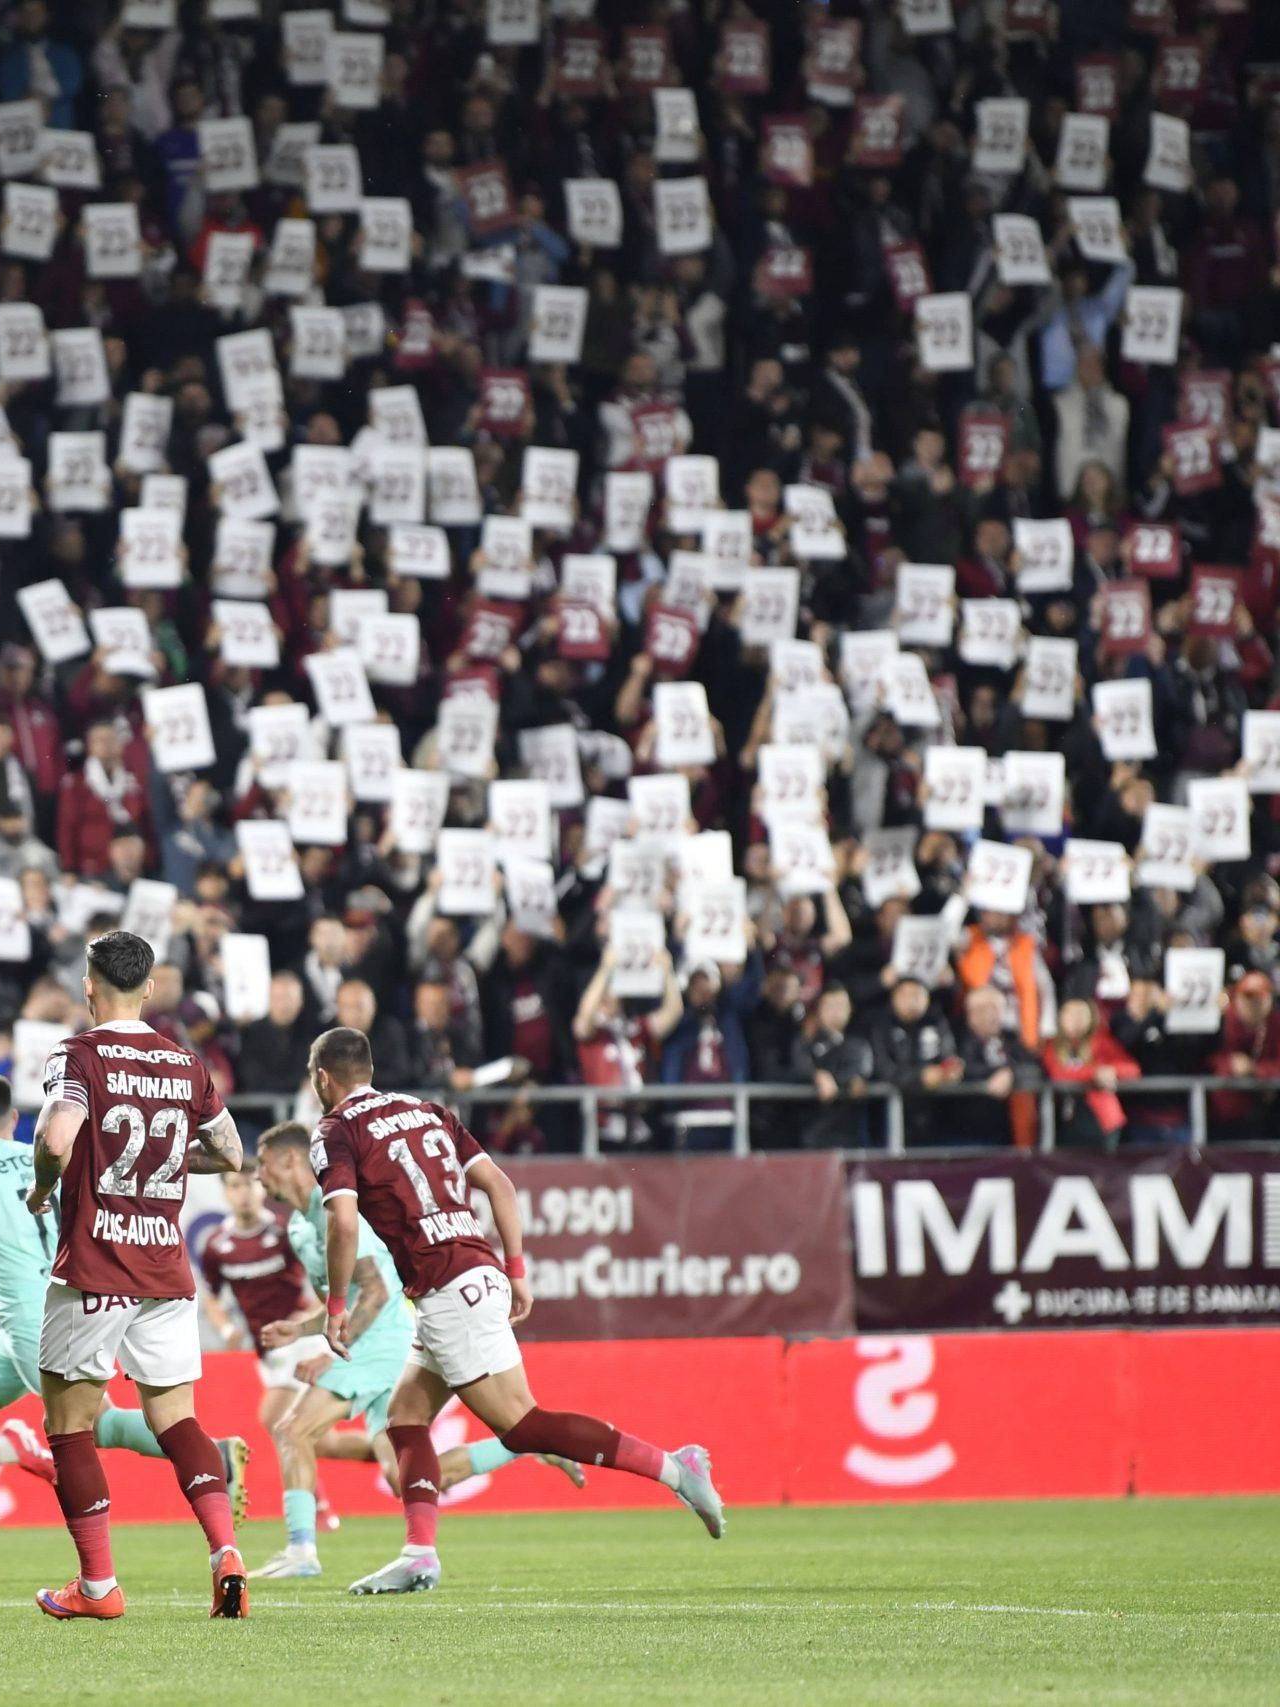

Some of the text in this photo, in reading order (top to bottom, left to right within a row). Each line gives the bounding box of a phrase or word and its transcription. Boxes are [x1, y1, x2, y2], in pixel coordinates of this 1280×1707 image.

[139, 533, 167, 562] 22
[165, 719, 195, 743] 22
[778, 770, 808, 800] 22
[940, 778, 970, 805] 22
[507, 810, 538, 837] 22
[1205, 808, 1235, 835] 22
[789, 843, 814, 866] 22
[1156, 832, 1187, 862] 22
[454, 858, 483, 887] 22
[987, 861, 1015, 882] 22
[704, 909, 733, 935] 22
[623, 942, 654, 969] 22
[1183, 979, 1211, 1008] 22
[98, 1104, 189, 1200] 22
[388, 1128, 466, 1215] 13
[853, 1172, 1280, 1277] IMAM
[523, 1244, 801, 1299] tarCurier.ro
